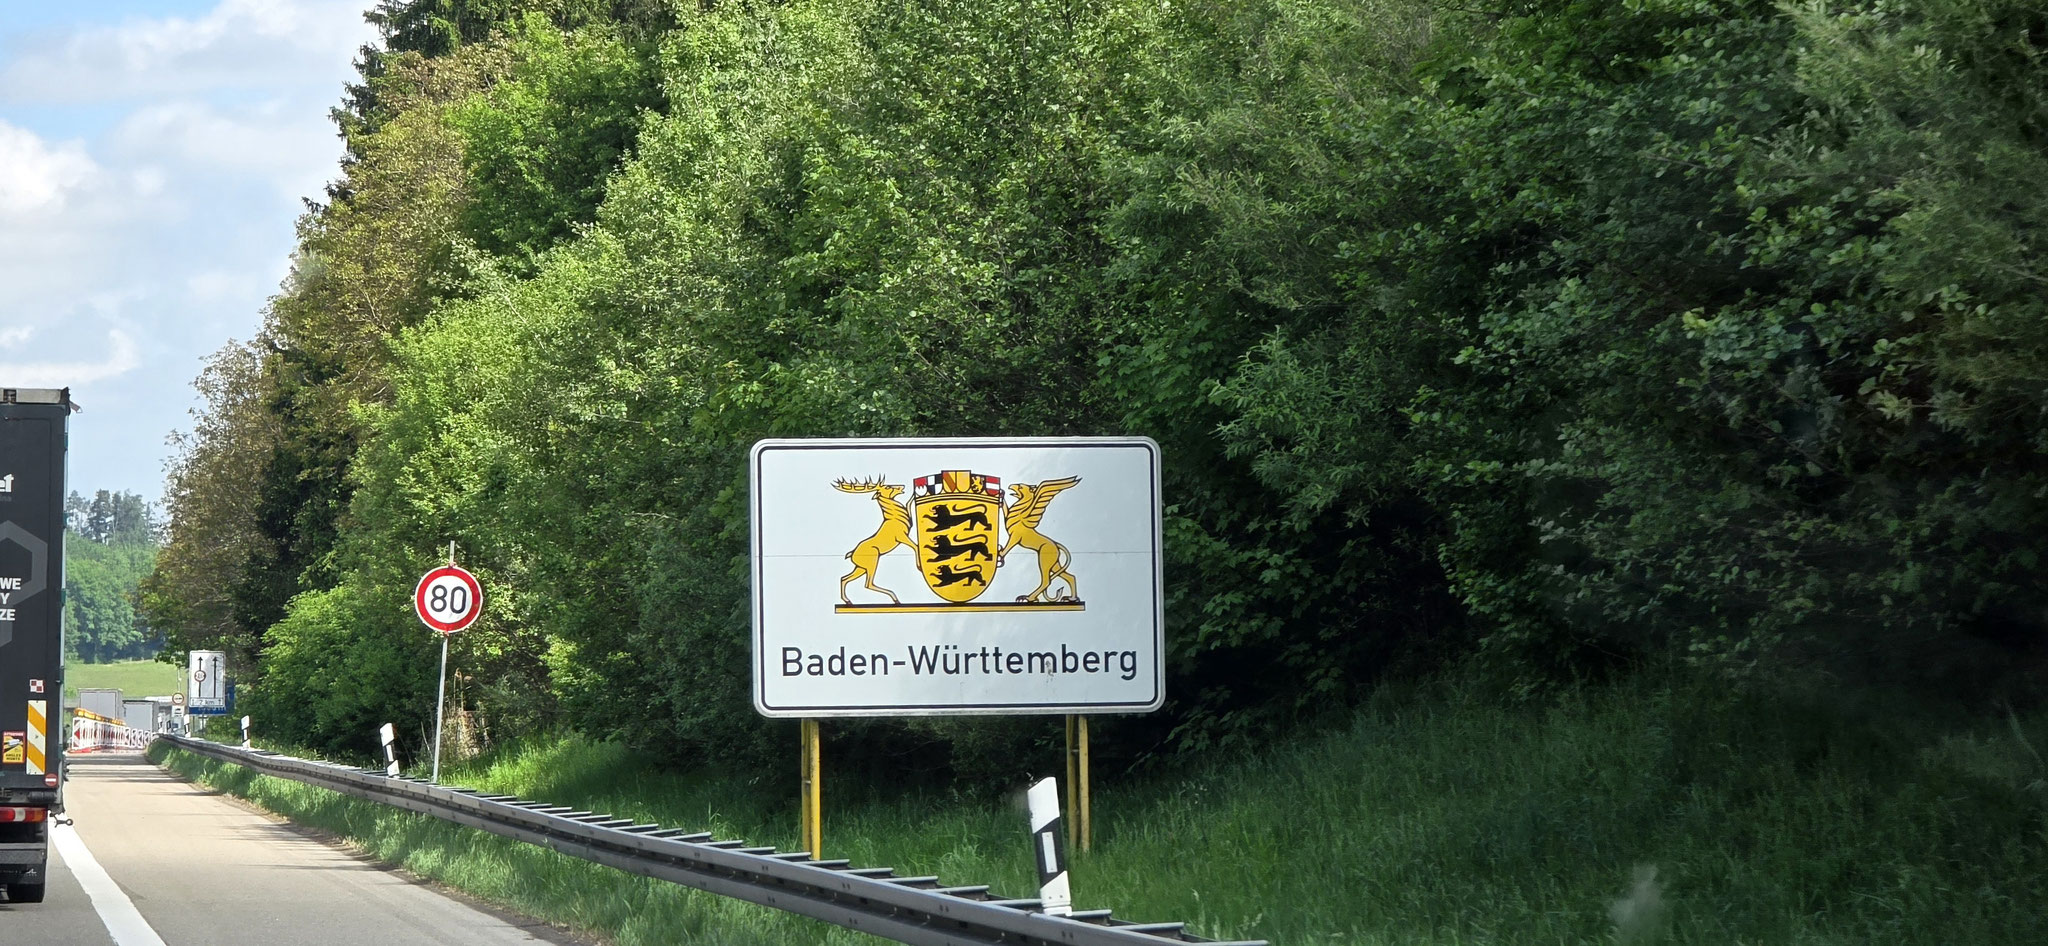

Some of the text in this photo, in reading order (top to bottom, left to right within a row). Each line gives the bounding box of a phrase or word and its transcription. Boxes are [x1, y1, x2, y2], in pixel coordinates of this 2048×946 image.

[0, 577, 21, 590] WE
[430, 584, 467, 614] 80
[782, 643, 1137, 681] Baden-Württemberg
